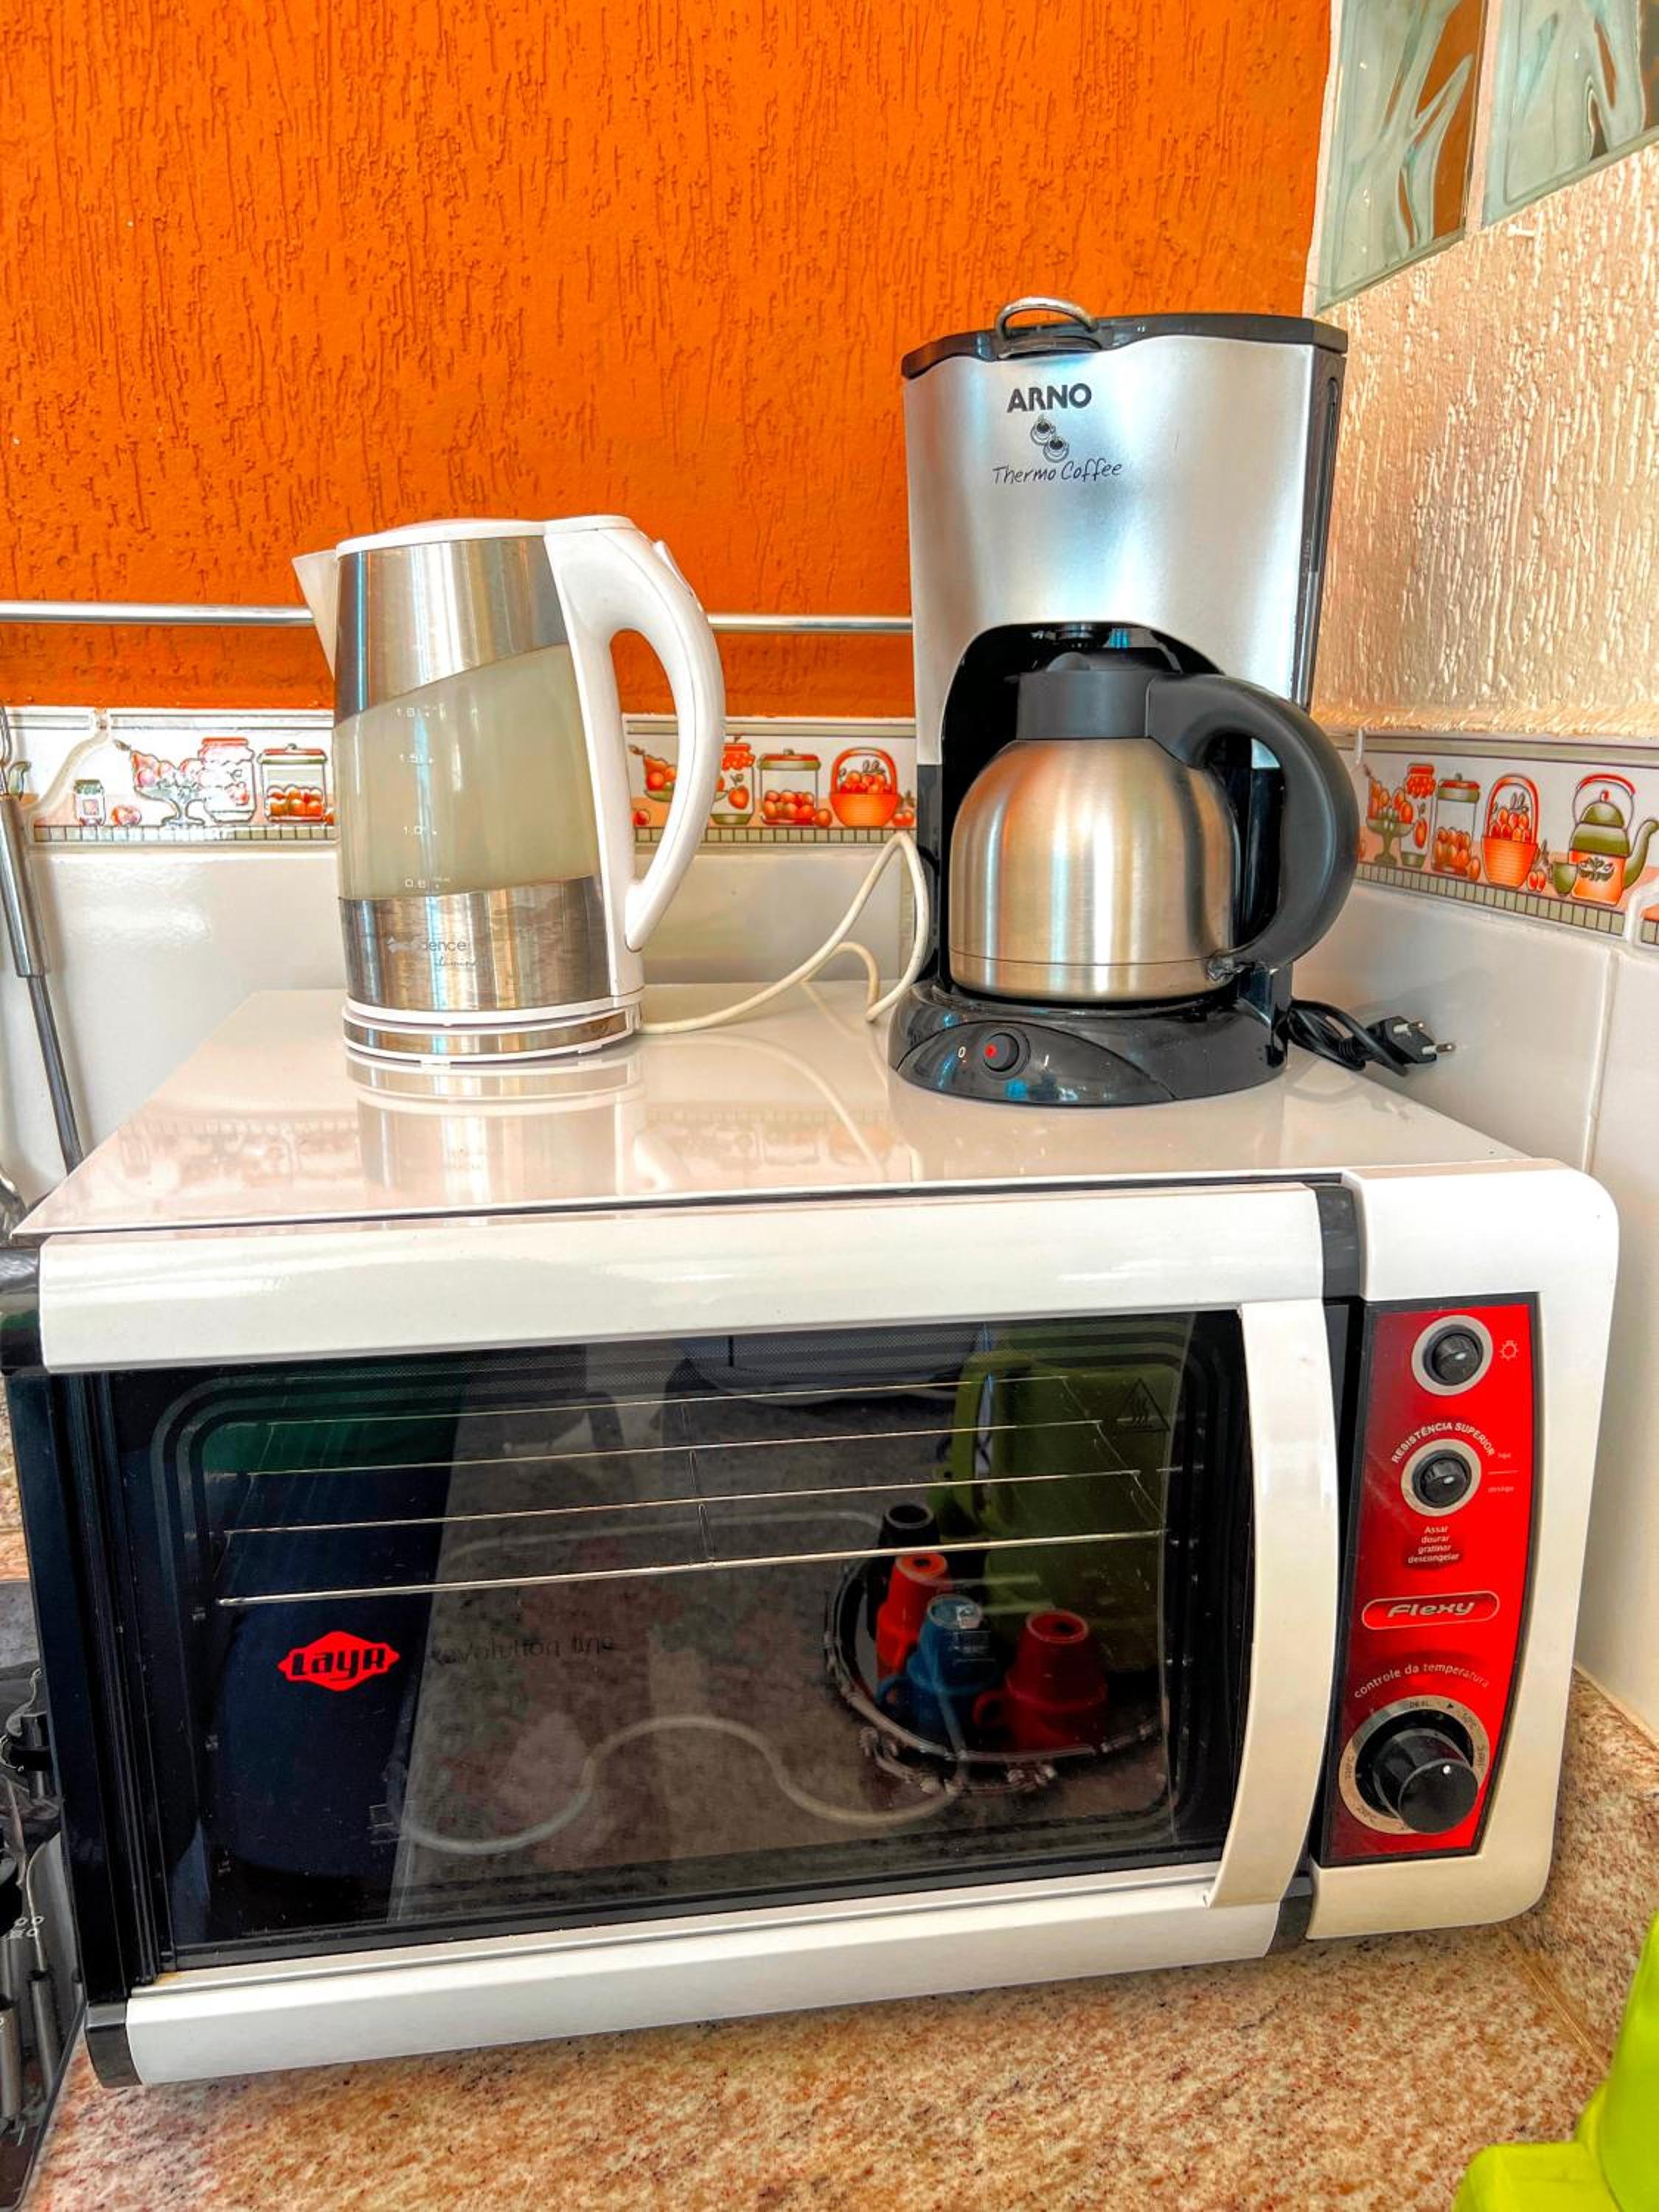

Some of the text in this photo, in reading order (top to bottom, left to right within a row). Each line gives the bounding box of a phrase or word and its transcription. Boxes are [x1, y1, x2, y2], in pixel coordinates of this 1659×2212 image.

[1006, 383, 1092, 413] ARNO
[992, 457, 1123, 484] Thermo Coffee
[1454, 1422, 1495, 1457] SUPERIOR
[1387, 1602, 1475, 1618] Flexy
[1354, 1663, 1489, 1698] controle da temperatura
